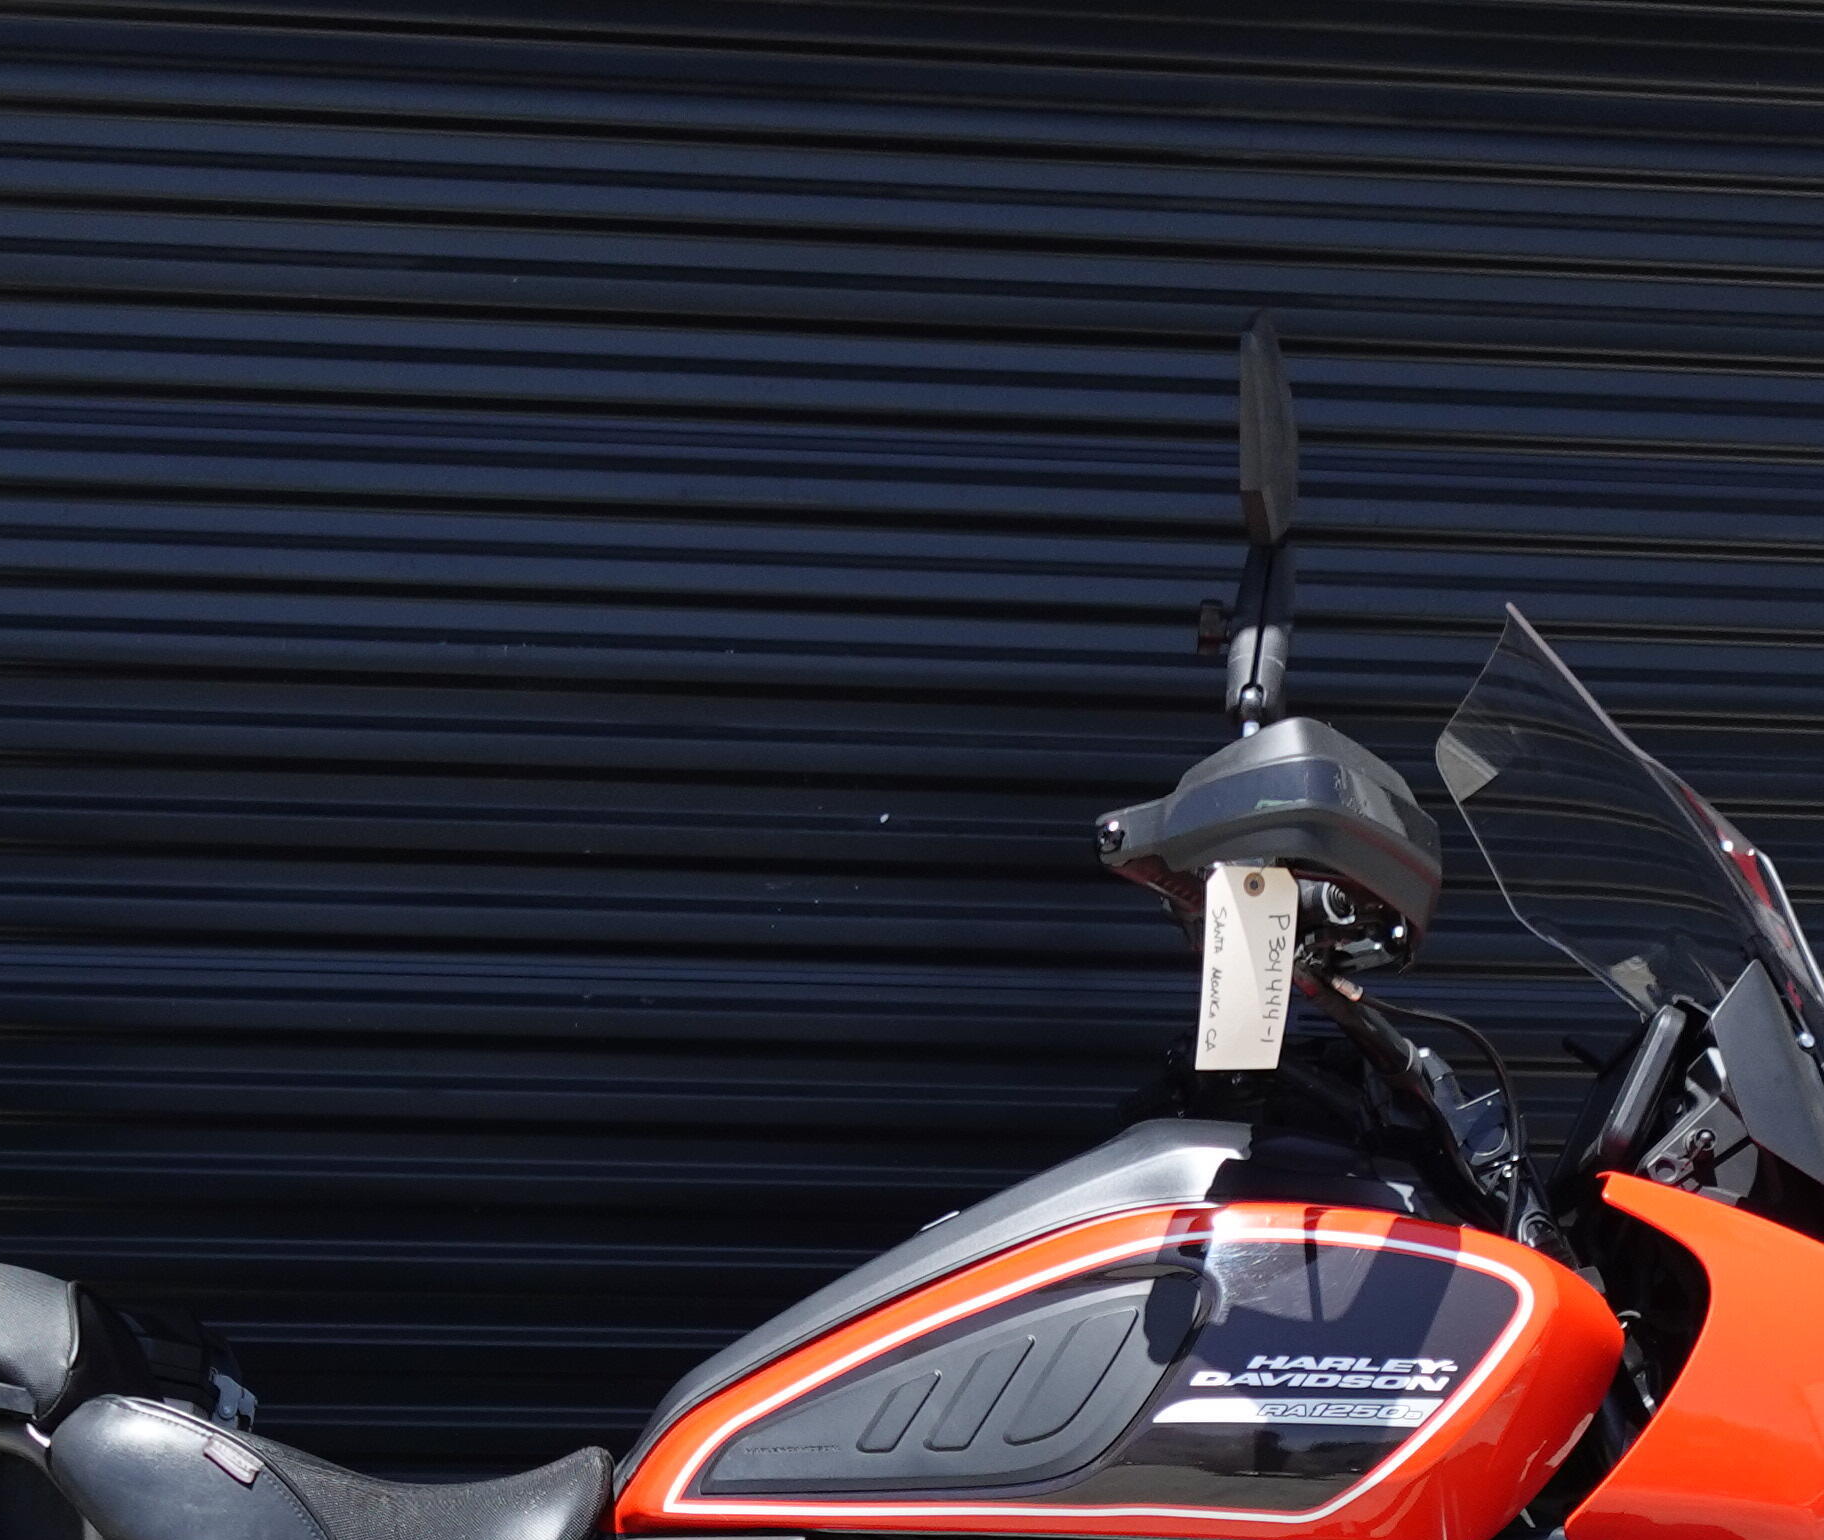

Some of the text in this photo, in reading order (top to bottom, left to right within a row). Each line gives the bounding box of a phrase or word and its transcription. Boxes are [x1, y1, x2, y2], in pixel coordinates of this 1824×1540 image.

[1212, 907, 1227, 953] SANTA
[1206, 1029, 1217, 1052] CA
[1246, 1354, 1458, 1373] HARLEY-
[1189, 1370, 1450, 1392] DAVIDSON
